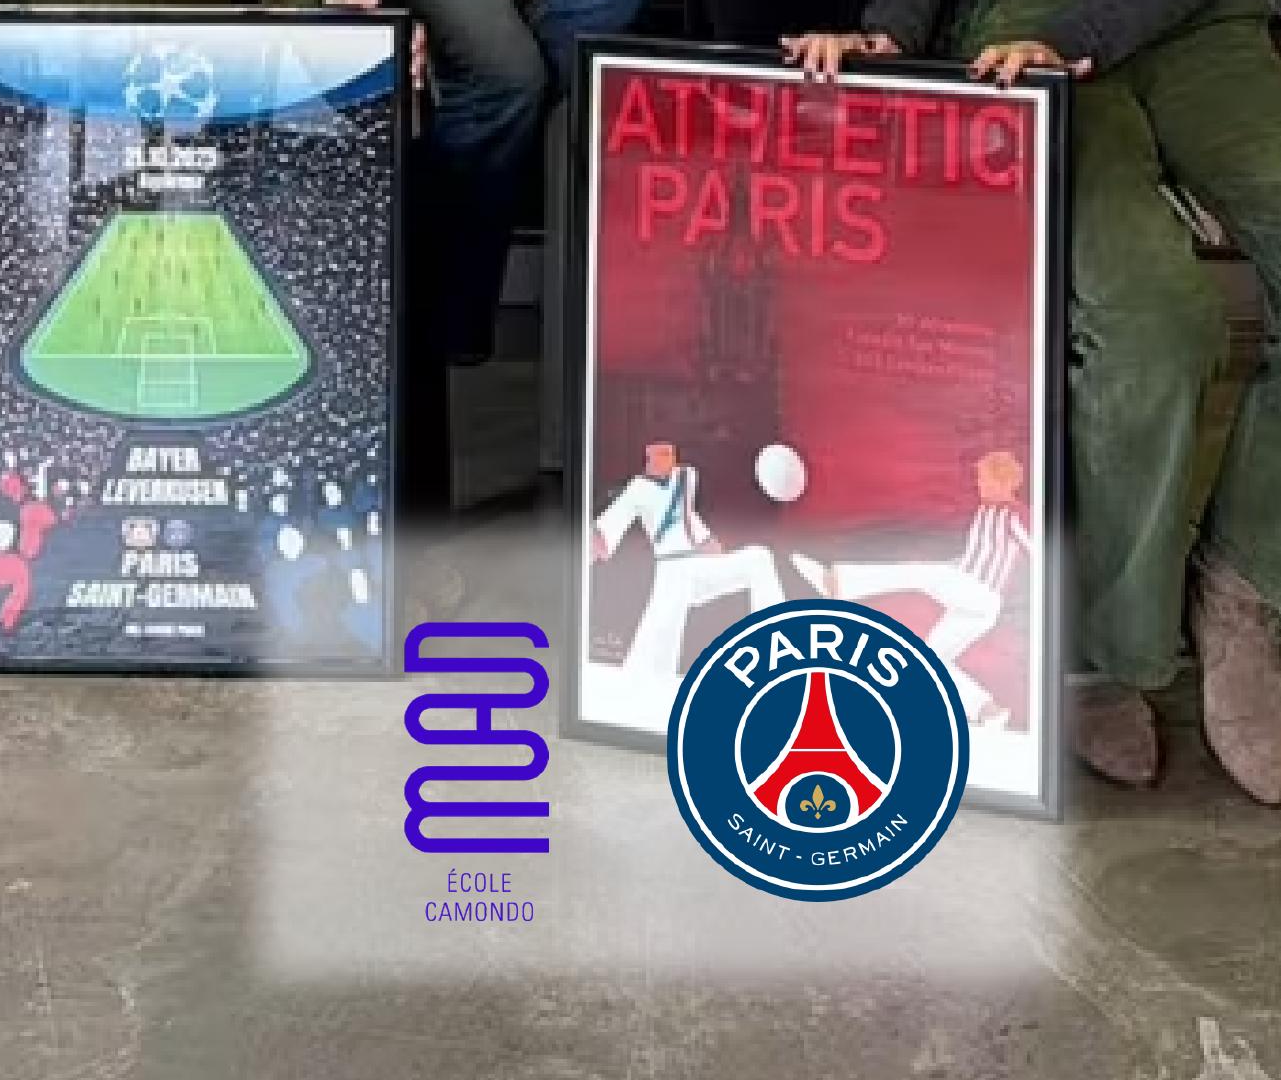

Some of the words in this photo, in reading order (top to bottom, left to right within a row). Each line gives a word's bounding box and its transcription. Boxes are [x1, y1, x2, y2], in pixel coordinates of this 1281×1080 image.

[608, 76, 1024, 188] ATHLETIC
[636, 164, 892, 264] PARIS
[125, 446, 203, 473] BAYER
[121, 548, 200, 578] PARIS
